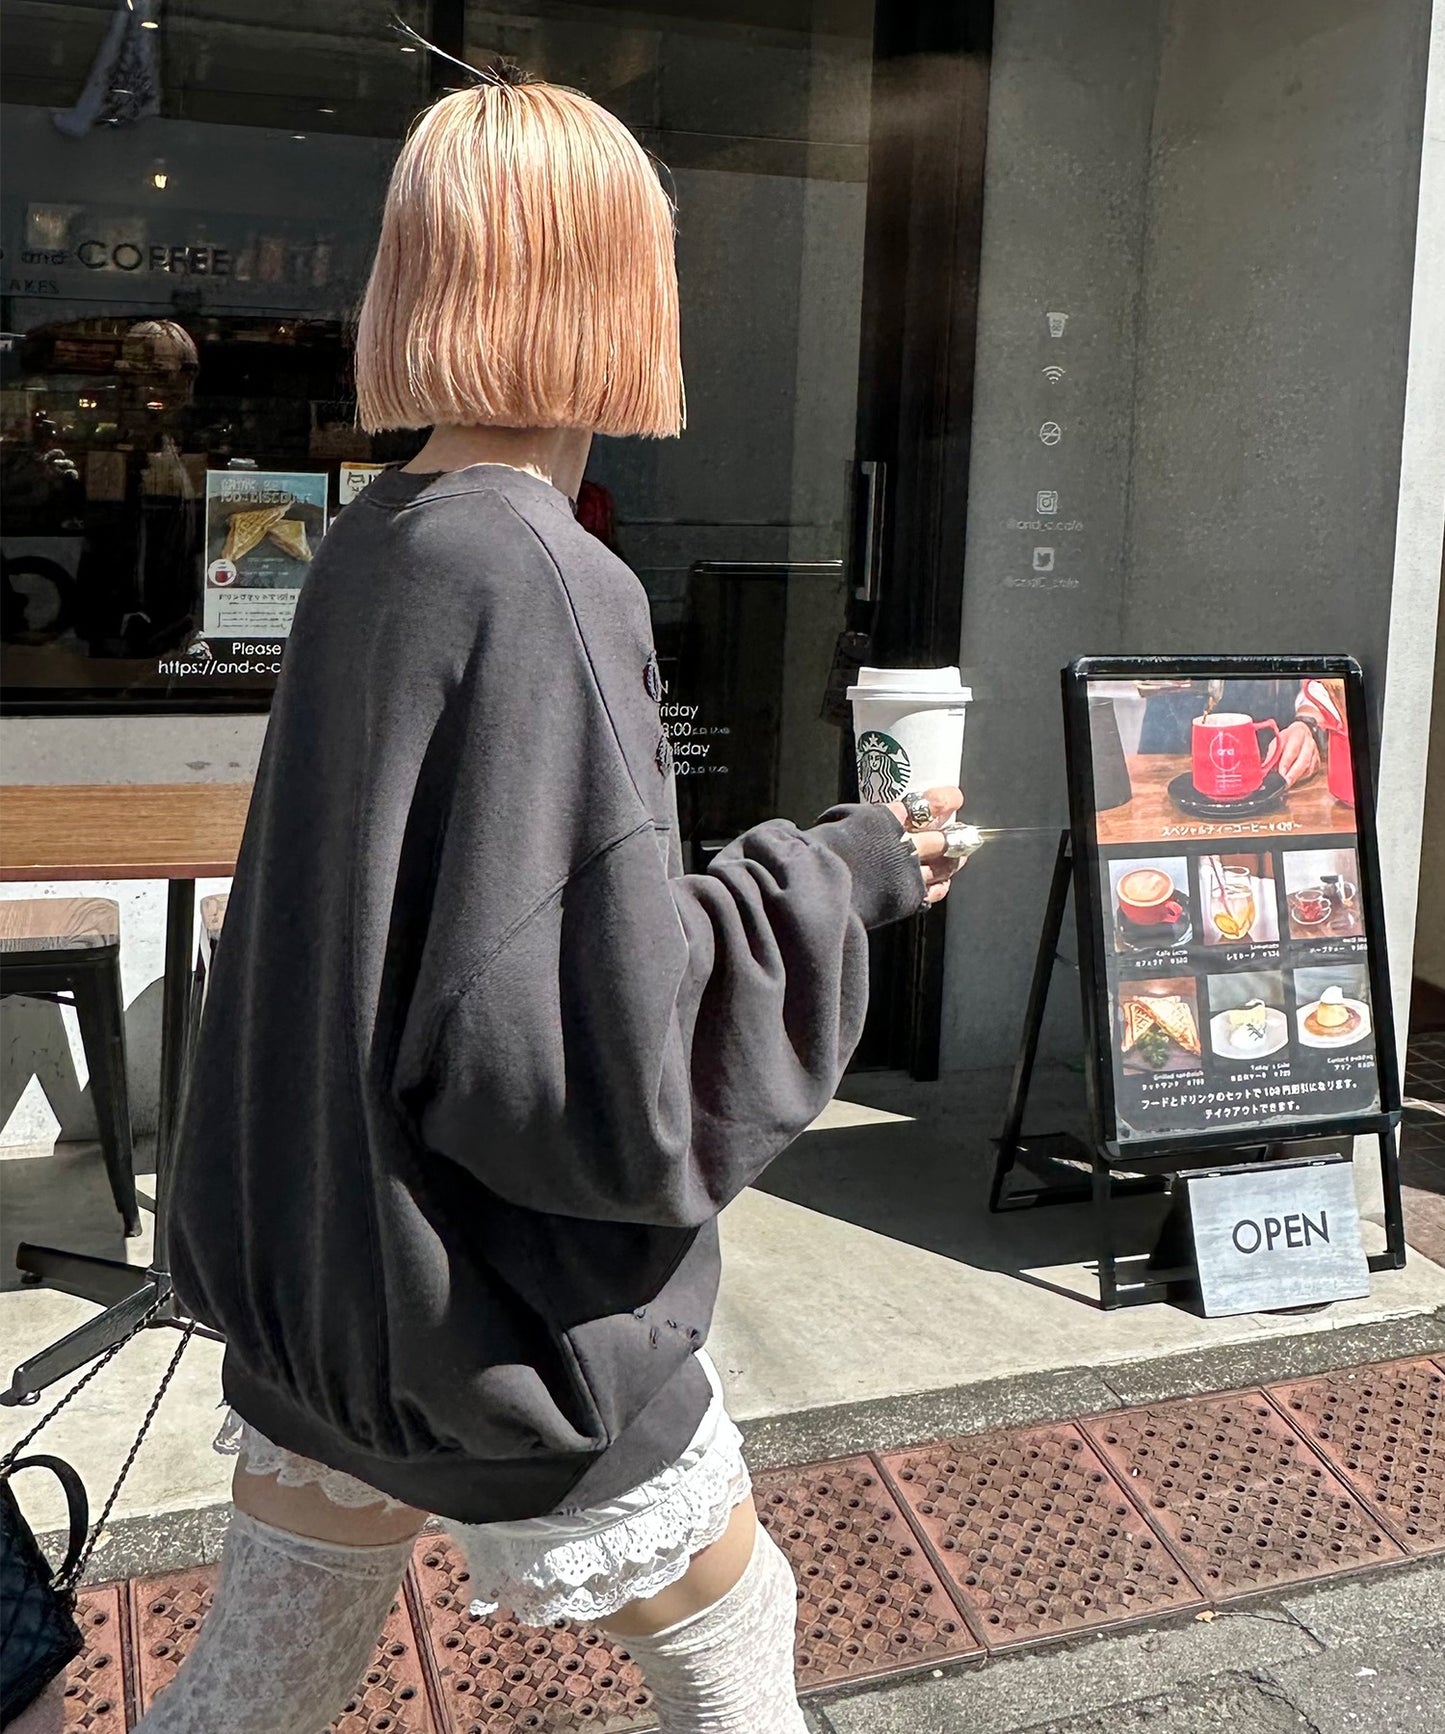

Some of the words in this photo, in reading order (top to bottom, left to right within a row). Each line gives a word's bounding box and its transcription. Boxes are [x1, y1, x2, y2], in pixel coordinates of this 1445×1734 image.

[77, 239, 233, 276] COFFEE
[232, 642, 282, 655] Please
[158, 660, 281, 677] https://and-c-c
[660, 703, 699, 719] riday
[673, 742, 710, 757] liday
[1232, 1210, 1330, 1254] OPEN
